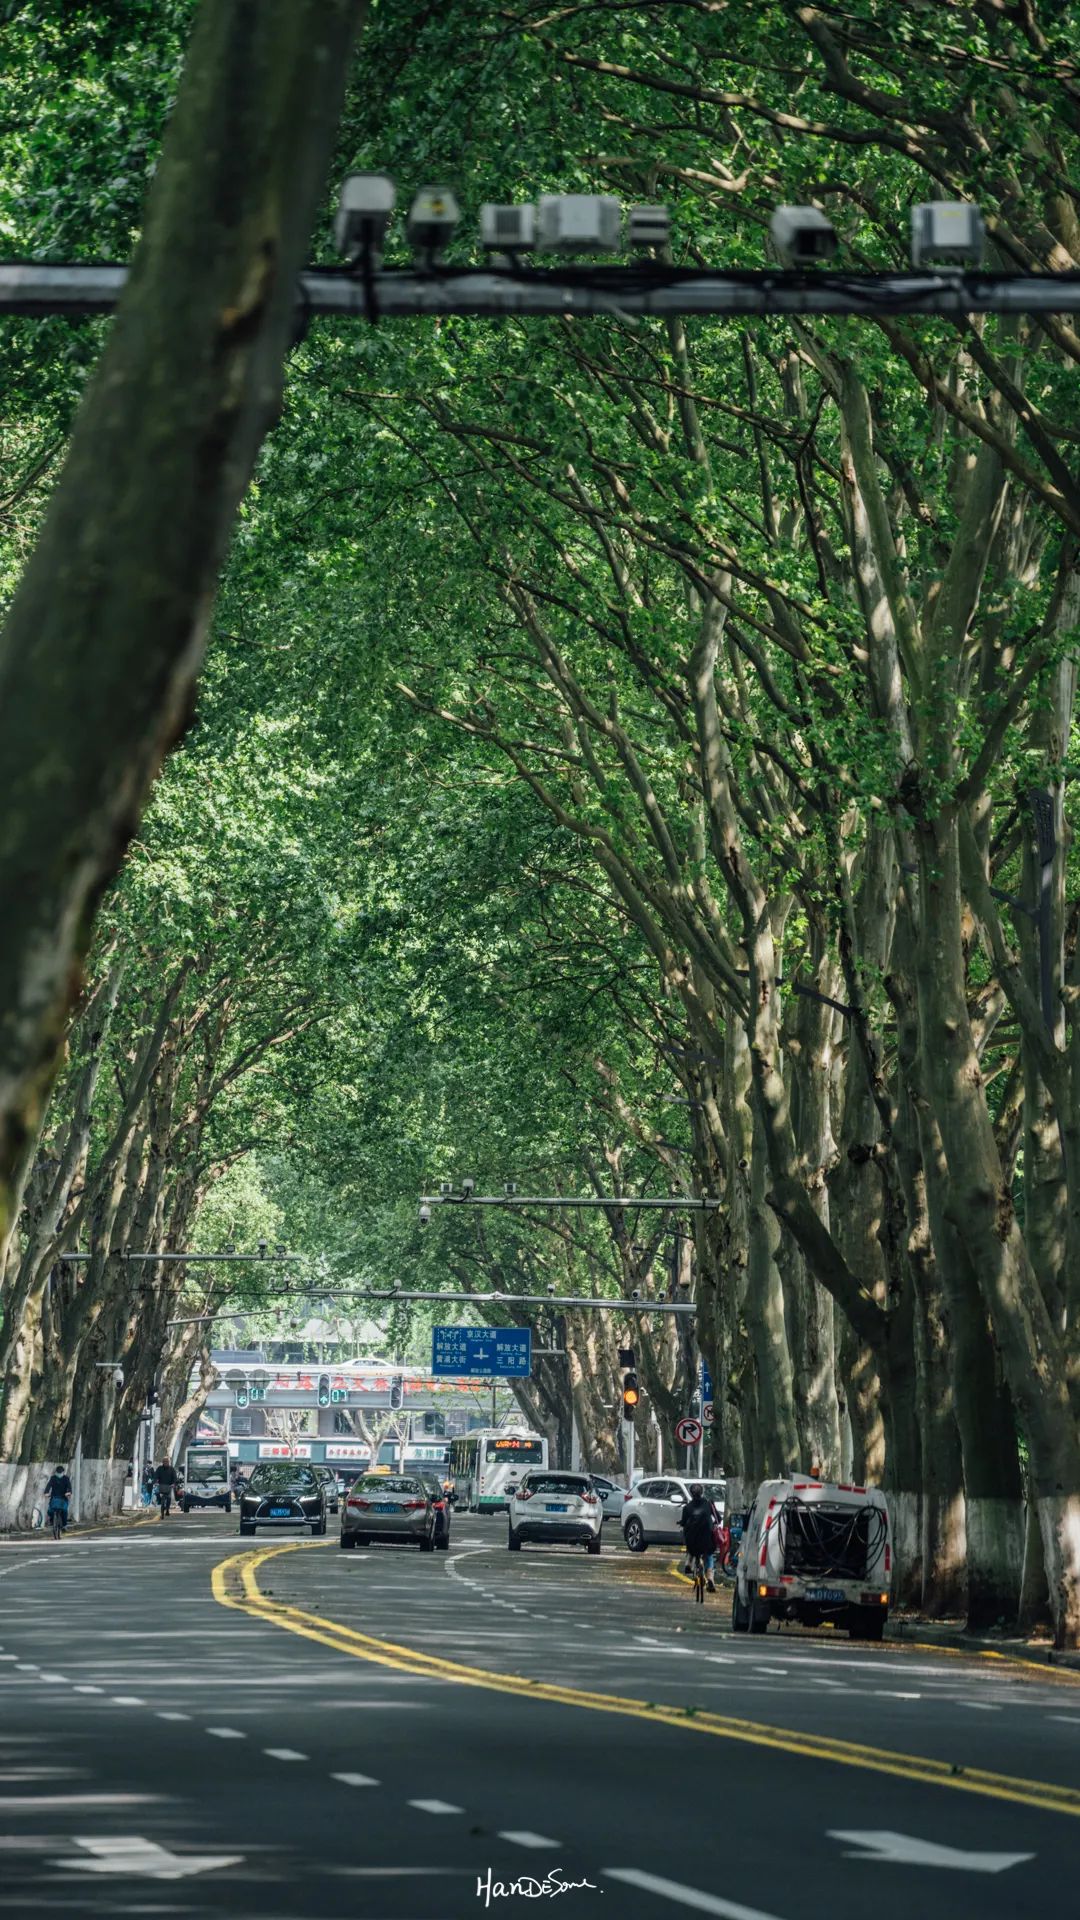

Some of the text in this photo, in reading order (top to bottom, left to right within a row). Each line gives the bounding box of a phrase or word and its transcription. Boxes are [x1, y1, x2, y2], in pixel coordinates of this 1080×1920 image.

[467, 1331, 496, 1339] 京汉大道
[436, 1343, 467, 1351] 解放大道
[496, 1344, 527, 1352] 解放大道
[496, 1357, 526, 1365] 三阳路
